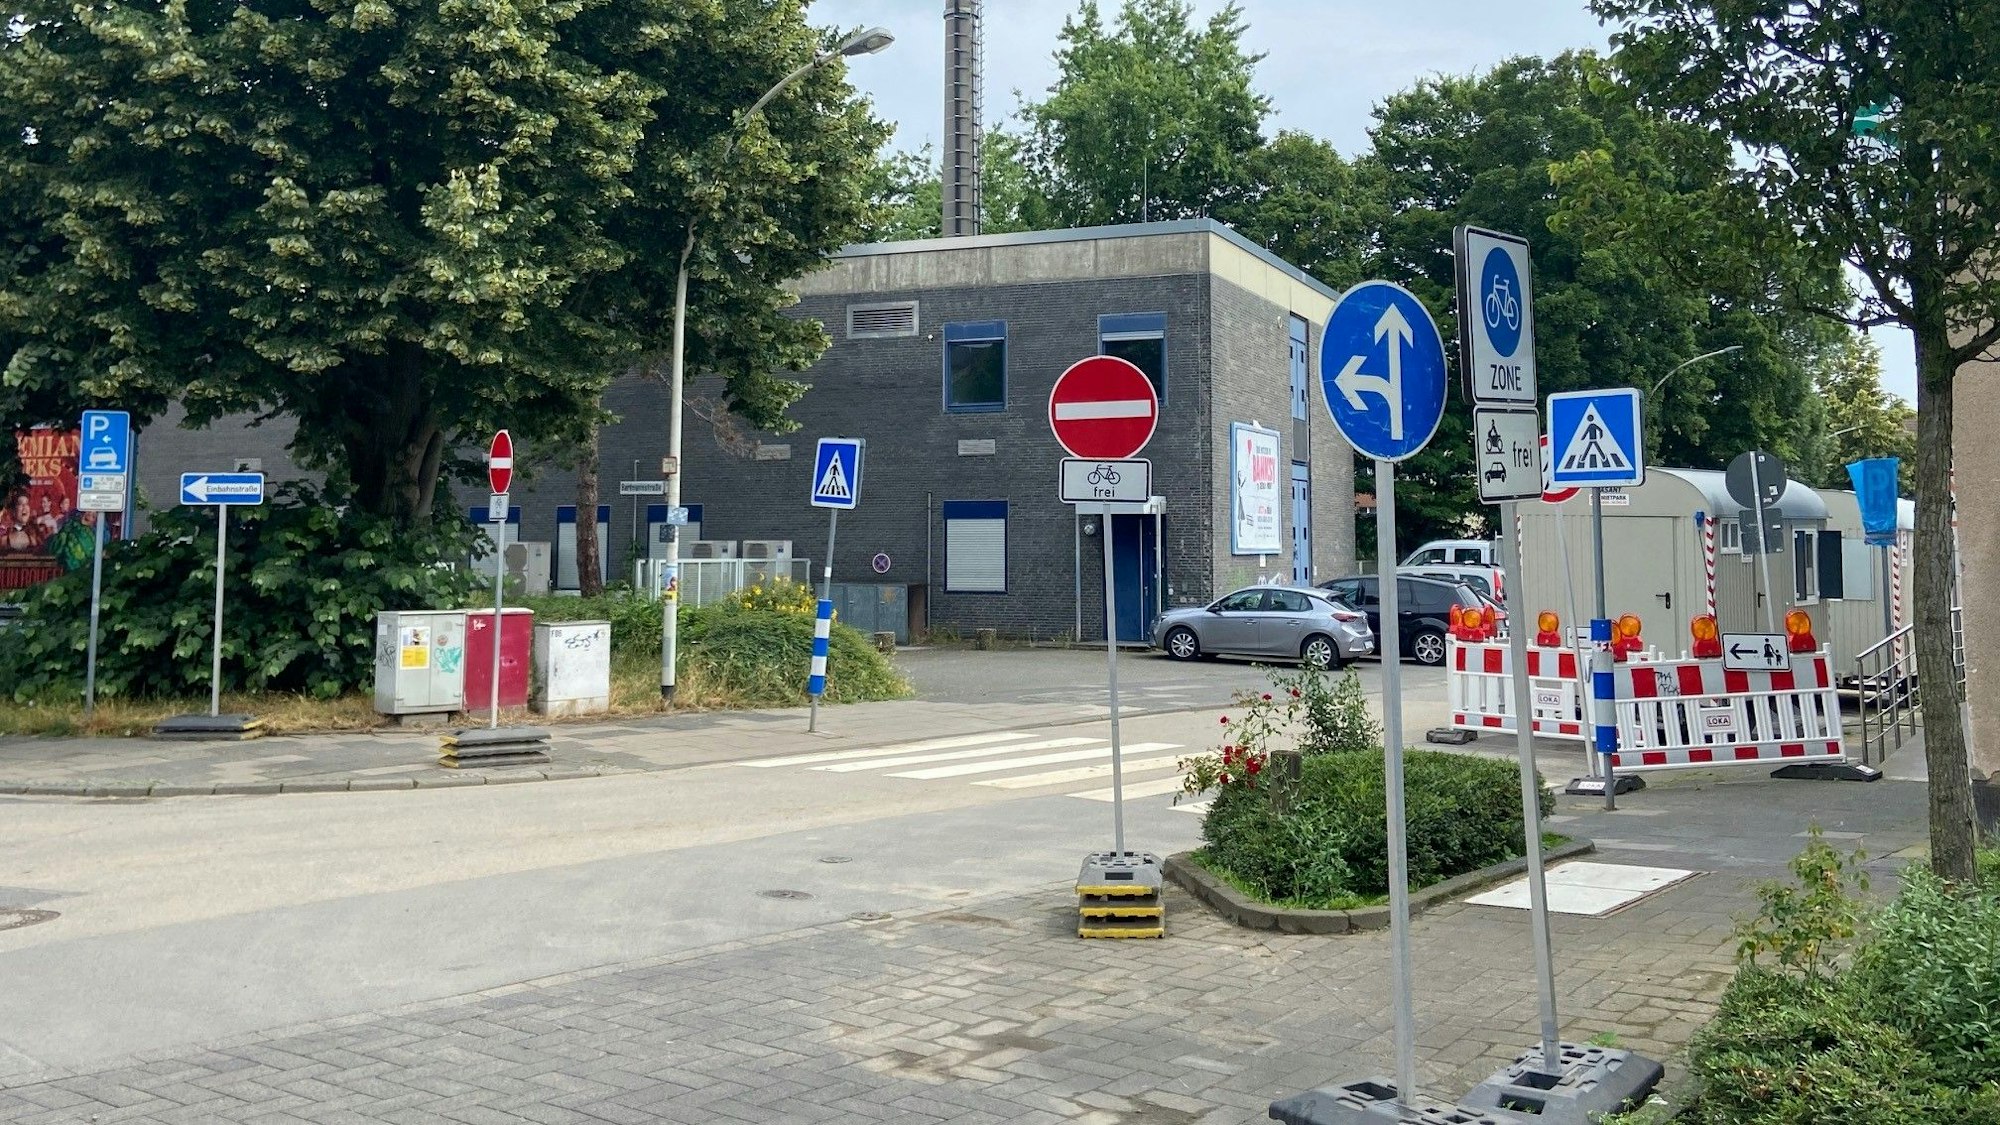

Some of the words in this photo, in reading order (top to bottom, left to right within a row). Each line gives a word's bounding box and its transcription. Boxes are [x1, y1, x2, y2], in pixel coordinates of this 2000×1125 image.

[1491, 364, 1522, 391] ZONE
[90, 415, 109, 440] P
[1512, 440, 1533, 468] frei
[206, 485, 258, 493] Einbahnstraße
[1093, 486, 1115, 497] frei
[1708, 717, 1729, 725] LOKA
